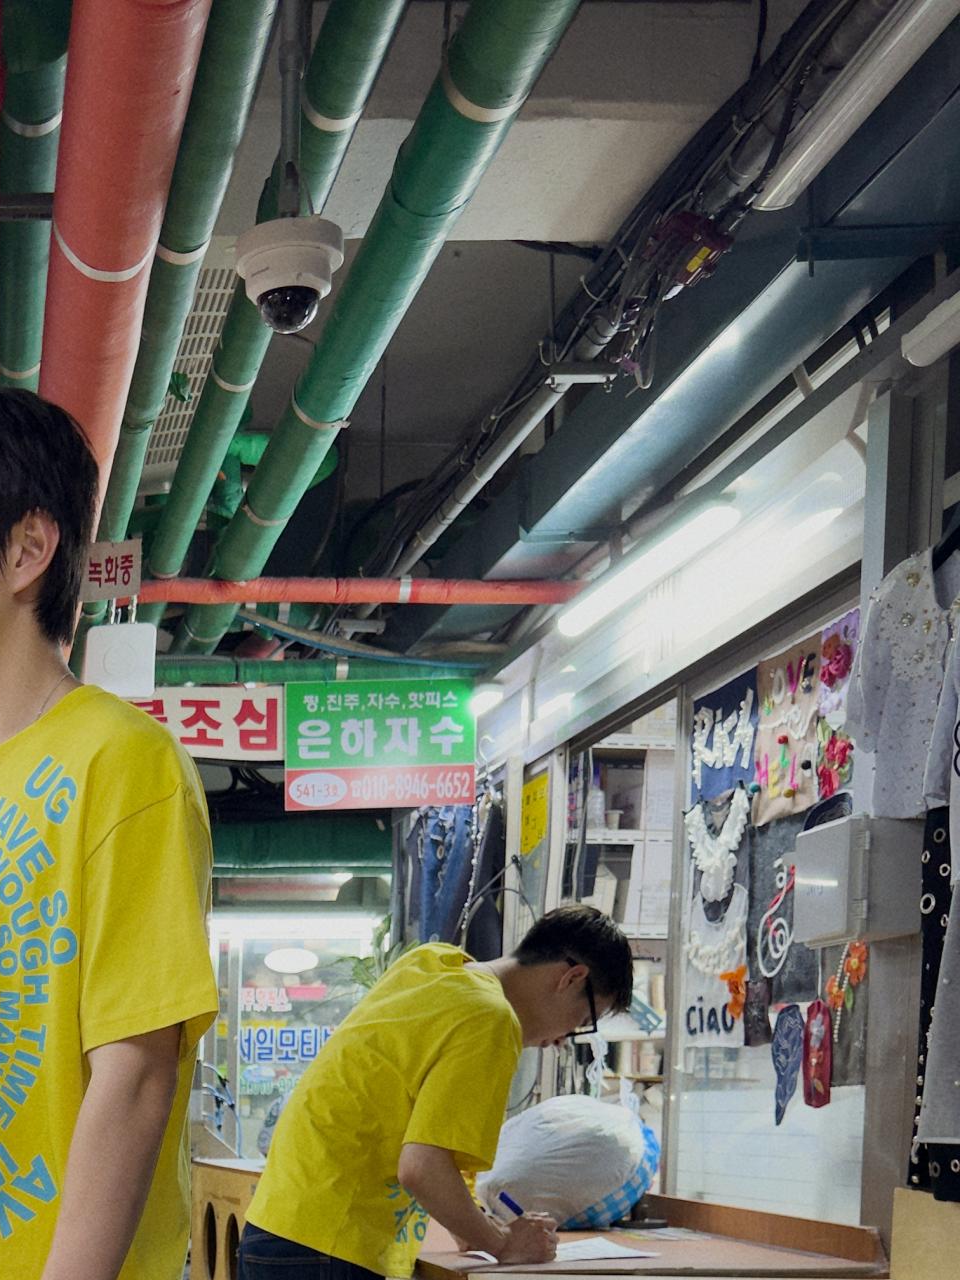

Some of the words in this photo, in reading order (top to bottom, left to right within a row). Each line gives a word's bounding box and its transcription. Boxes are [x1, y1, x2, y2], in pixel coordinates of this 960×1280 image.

[89, 553, 134, 588] 녹화중
[297, 716, 464, 760] 은하자수
[39, 889, 79, 966] SO
